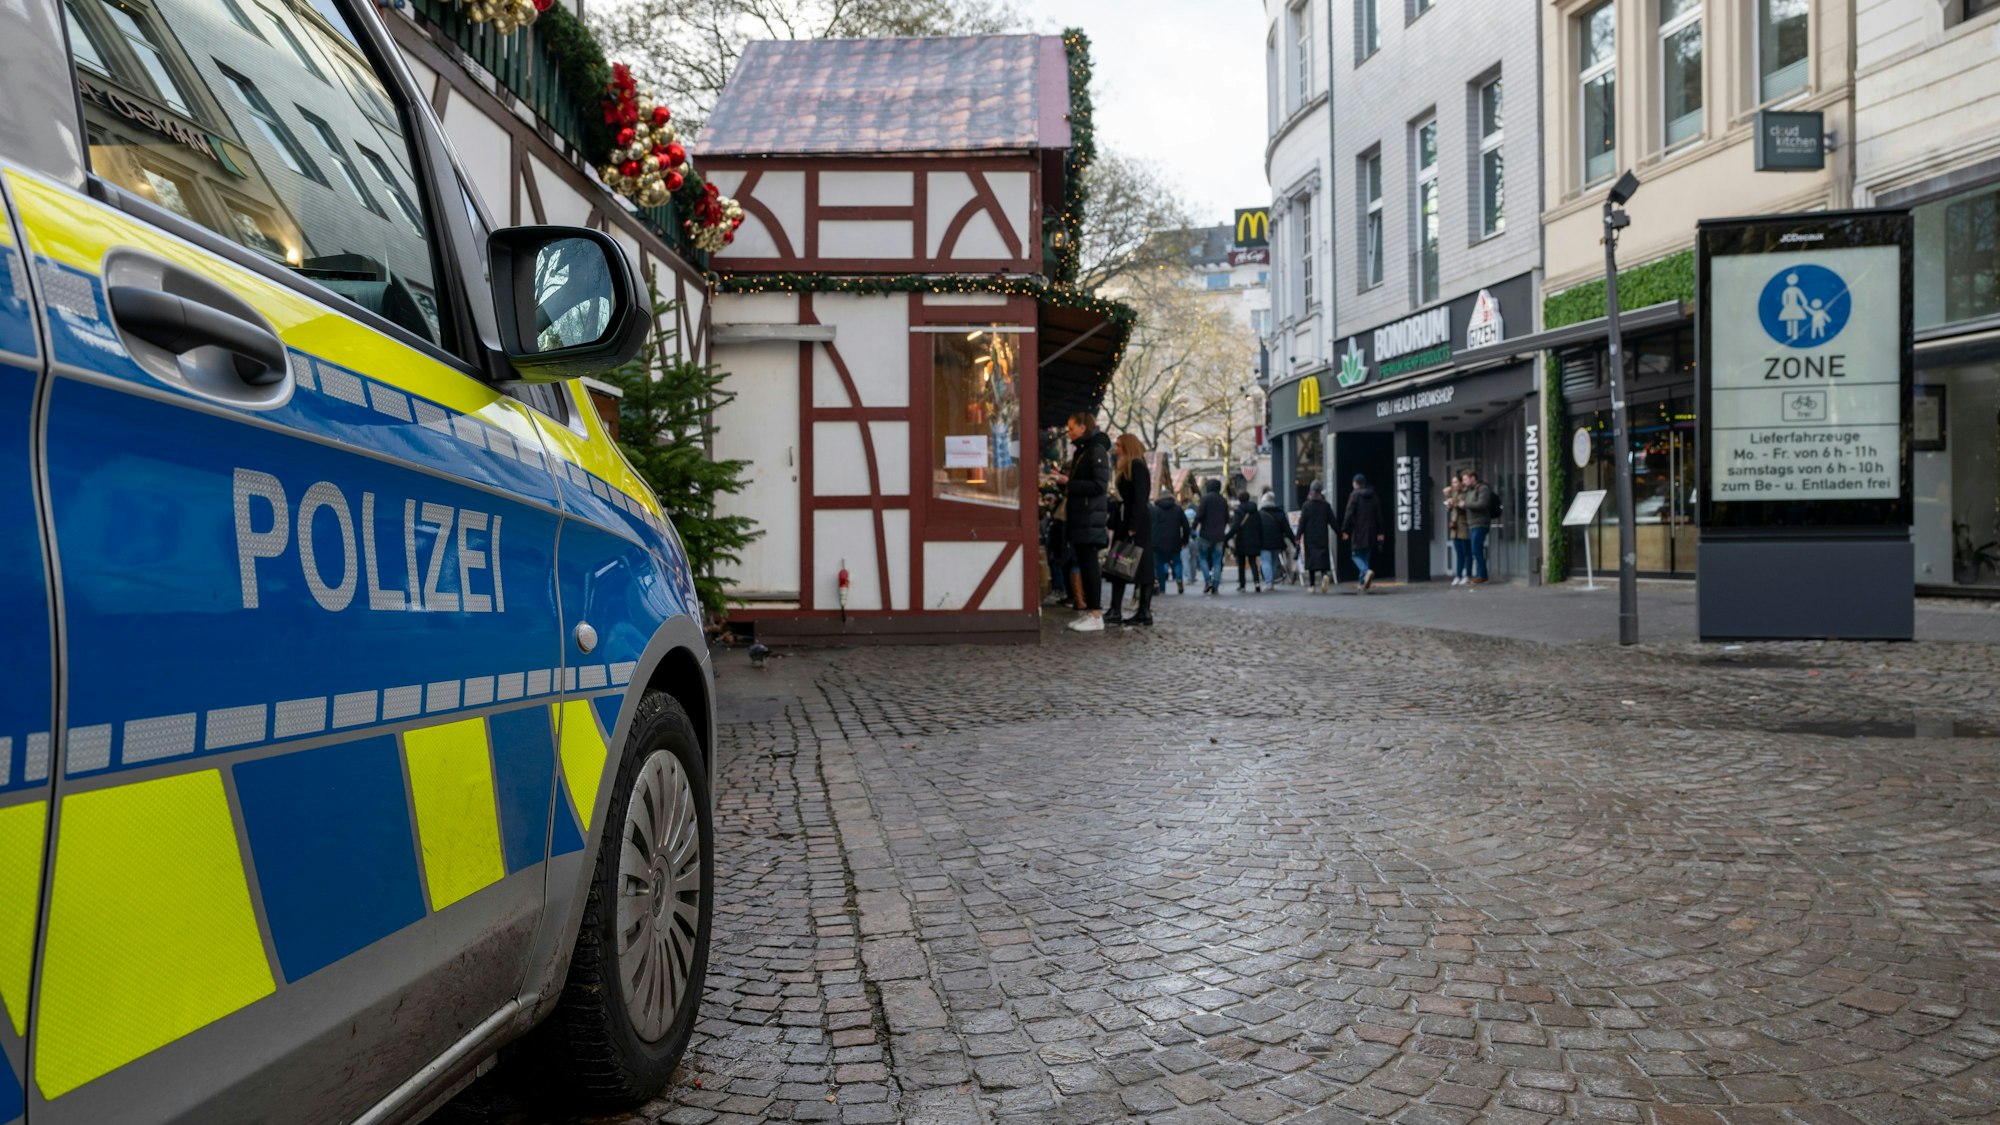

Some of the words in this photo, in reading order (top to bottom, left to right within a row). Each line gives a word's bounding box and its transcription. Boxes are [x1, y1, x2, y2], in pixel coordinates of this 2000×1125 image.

[1770, 125, 1799, 136] cloud
[1776, 137, 1817, 148] kitchen
[1374, 306, 1450, 362] BONORUM
[1470, 323, 1496, 347] GIZEH
[1764, 355, 1846, 380] ZONE
[1750, 431, 1860, 445] Lieferfahrzeuge
[1734, 448, 1757, 460] Mo.
[1773, 447, 1790, 459] Fr.
[1794, 449, 1818, 458] von
[1822, 447, 1831, 458] 6
[1834, 446, 1842, 457] h
[1413, 456, 1421, 492] PARTNER
[1526, 425, 1539, 538] BONORUM
[1728, 465, 1794, 477] samstags
[1798, 465, 1822, 474] von
[1826, 462, 1834, 474] 6
[1838, 462, 1846, 473] h
[1397, 456, 1412, 531] GIZEH
[1721, 482, 1750, 491] zum
[1785, 482, 1797, 490] u.
[1802, 479, 1863, 490] Entladen
[1867, 477, 1891, 488] frei
[1413, 493, 1421, 530] PREMIUM
[233, 467, 504, 612] POLIZEI
